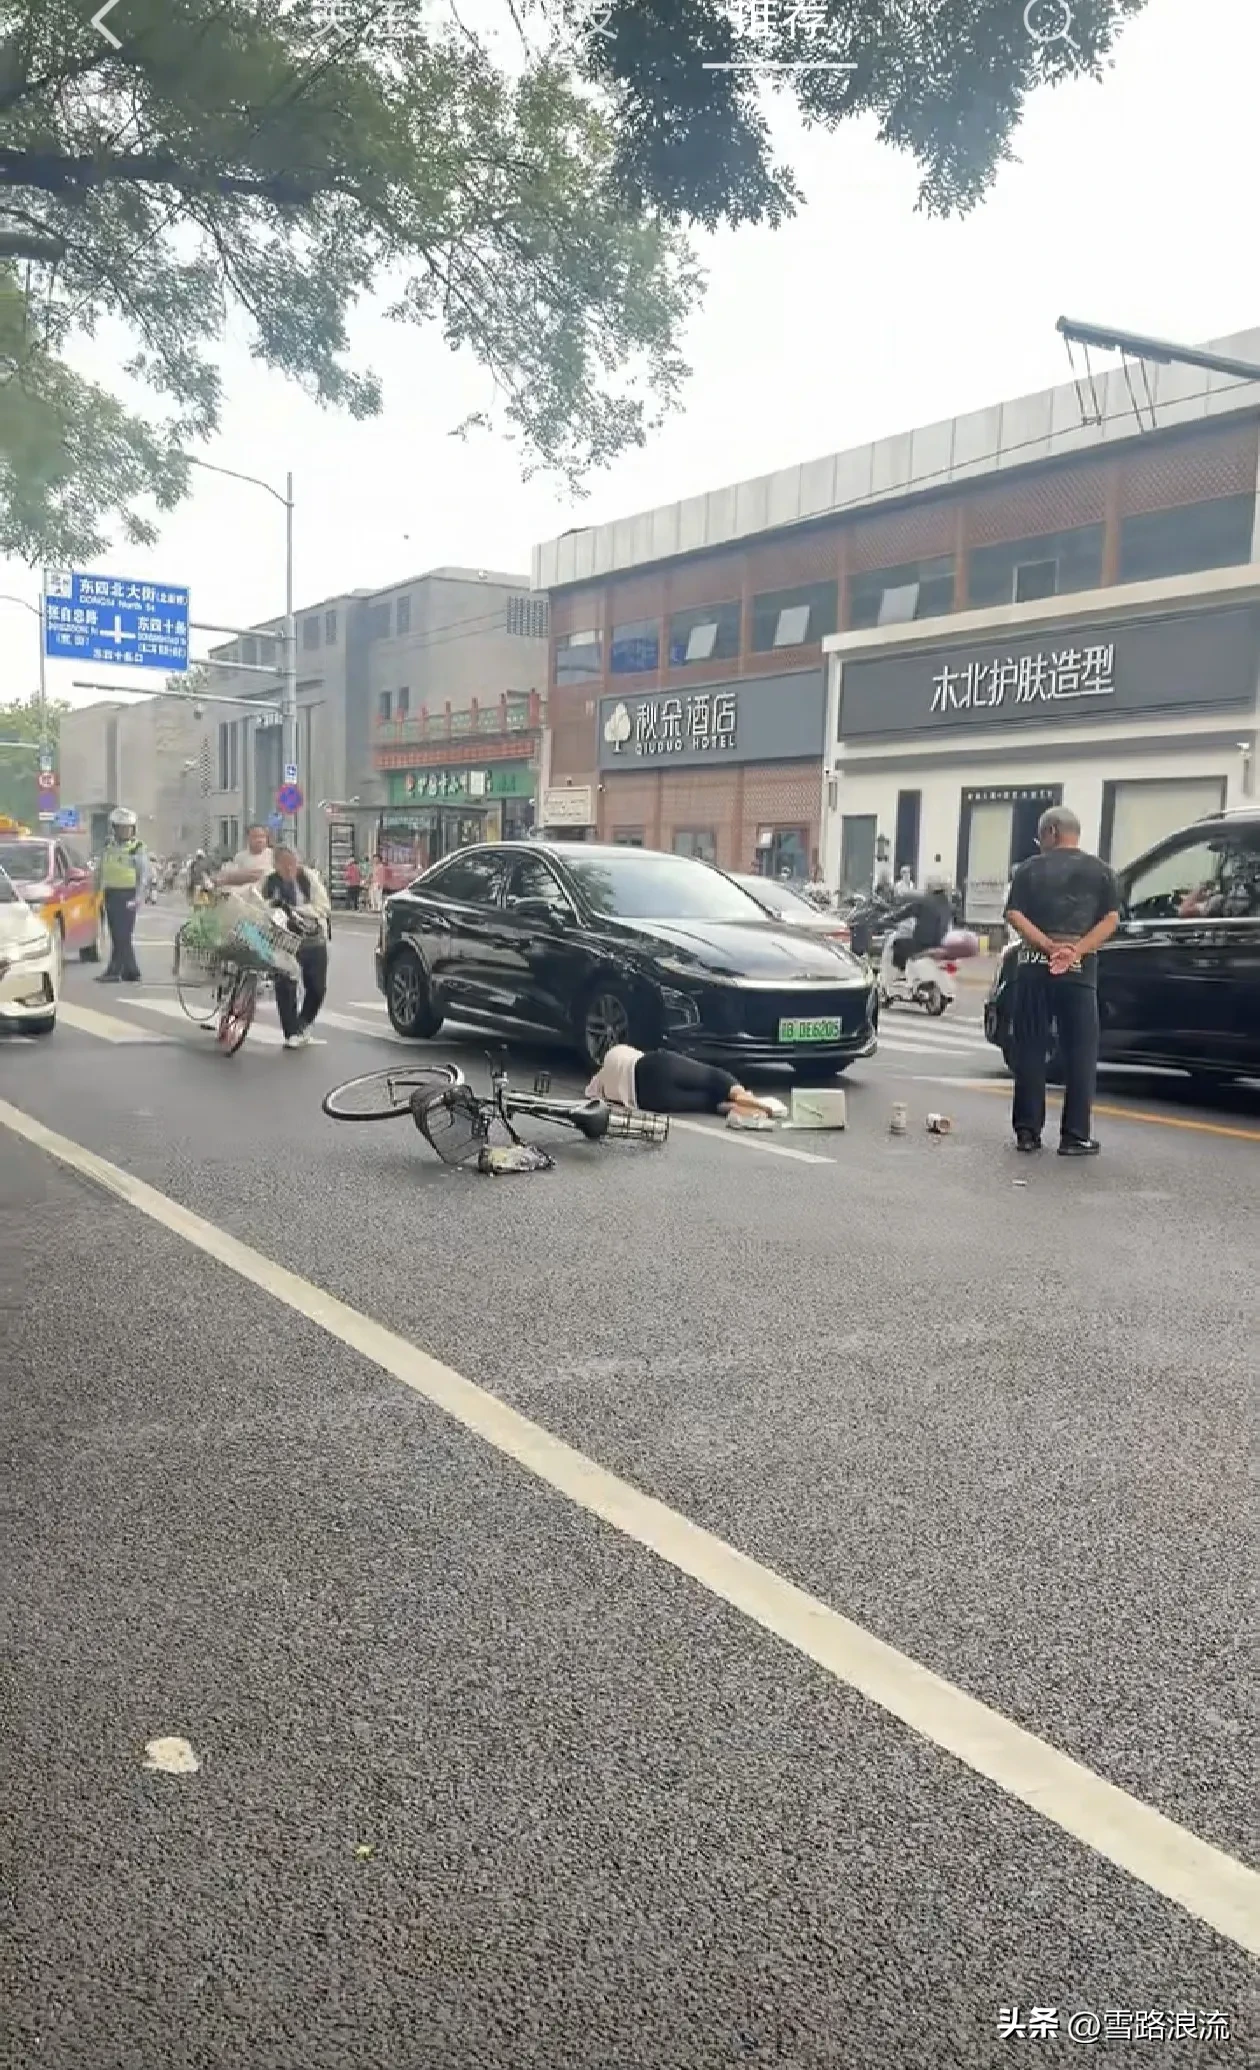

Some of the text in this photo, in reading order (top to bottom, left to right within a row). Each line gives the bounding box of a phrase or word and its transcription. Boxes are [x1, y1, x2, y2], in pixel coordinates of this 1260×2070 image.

[79, 578, 156, 602] 东四北大街
[929, 643, 1116, 713] 木北护肤造型
[636, 693, 736, 741] 秋朵酒店
[636, 734, 736, 756] QIUDUO HOTEL
